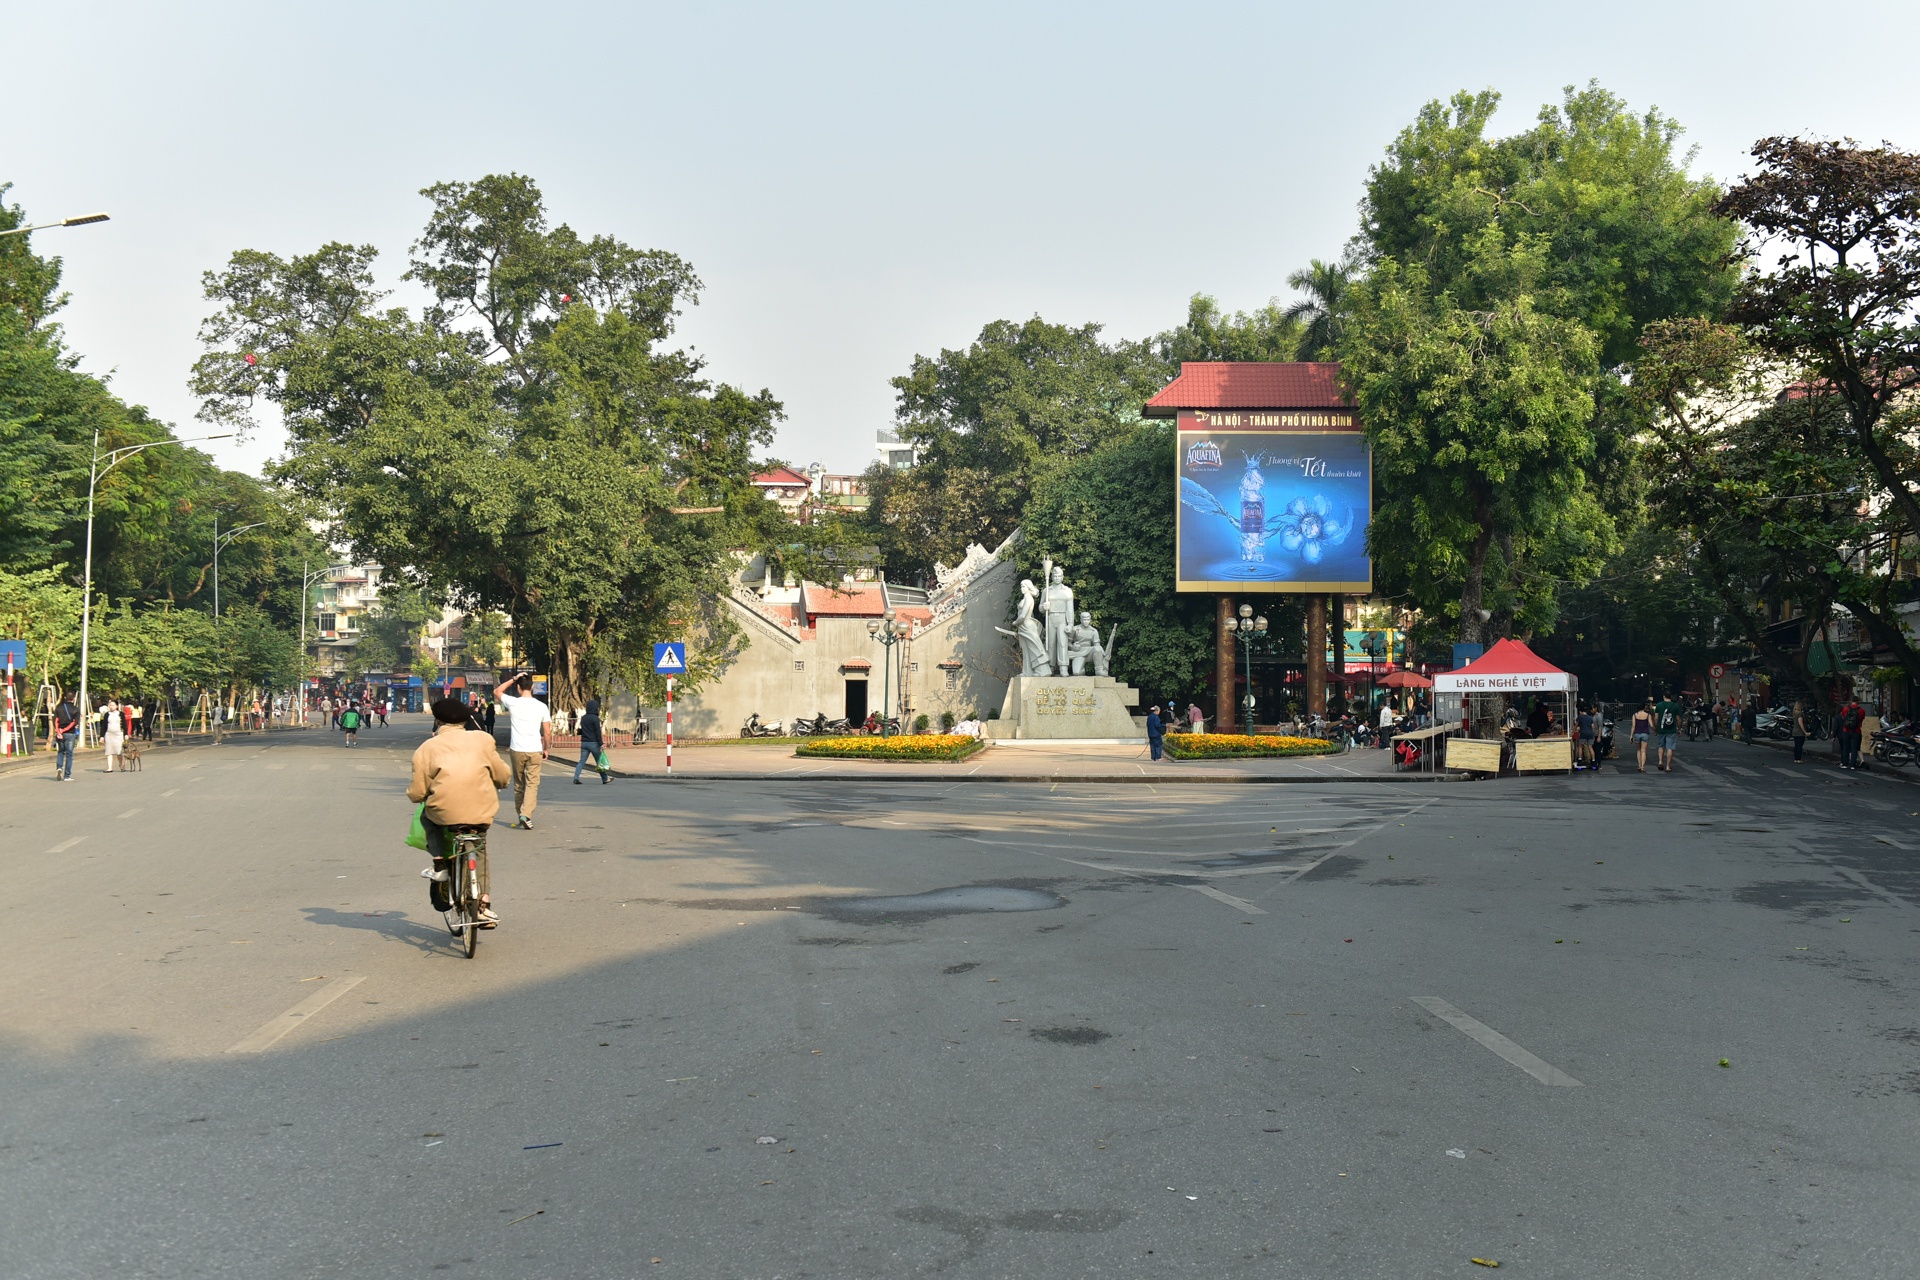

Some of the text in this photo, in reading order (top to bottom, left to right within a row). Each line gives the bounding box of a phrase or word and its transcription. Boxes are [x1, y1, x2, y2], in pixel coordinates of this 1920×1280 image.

[1210, 413, 1223, 426] HÀ
[1225, 413, 1241, 428] NỘI
[1249, 413, 1279, 426] THÀNH
[1281, 412, 1299, 426] PHỐ
[1301, 413, 1310, 426] VÌ
[1311, 413, 1329, 426] HÒA
[1331, 413, 1352, 426] BÌNH
[1185, 447, 1222, 466] AQUAFINA
[1300, 456, 1327, 477] Tết
[1456, 678, 1485, 687] LÀNG
[1522, 677, 1546, 688] VIỆT
